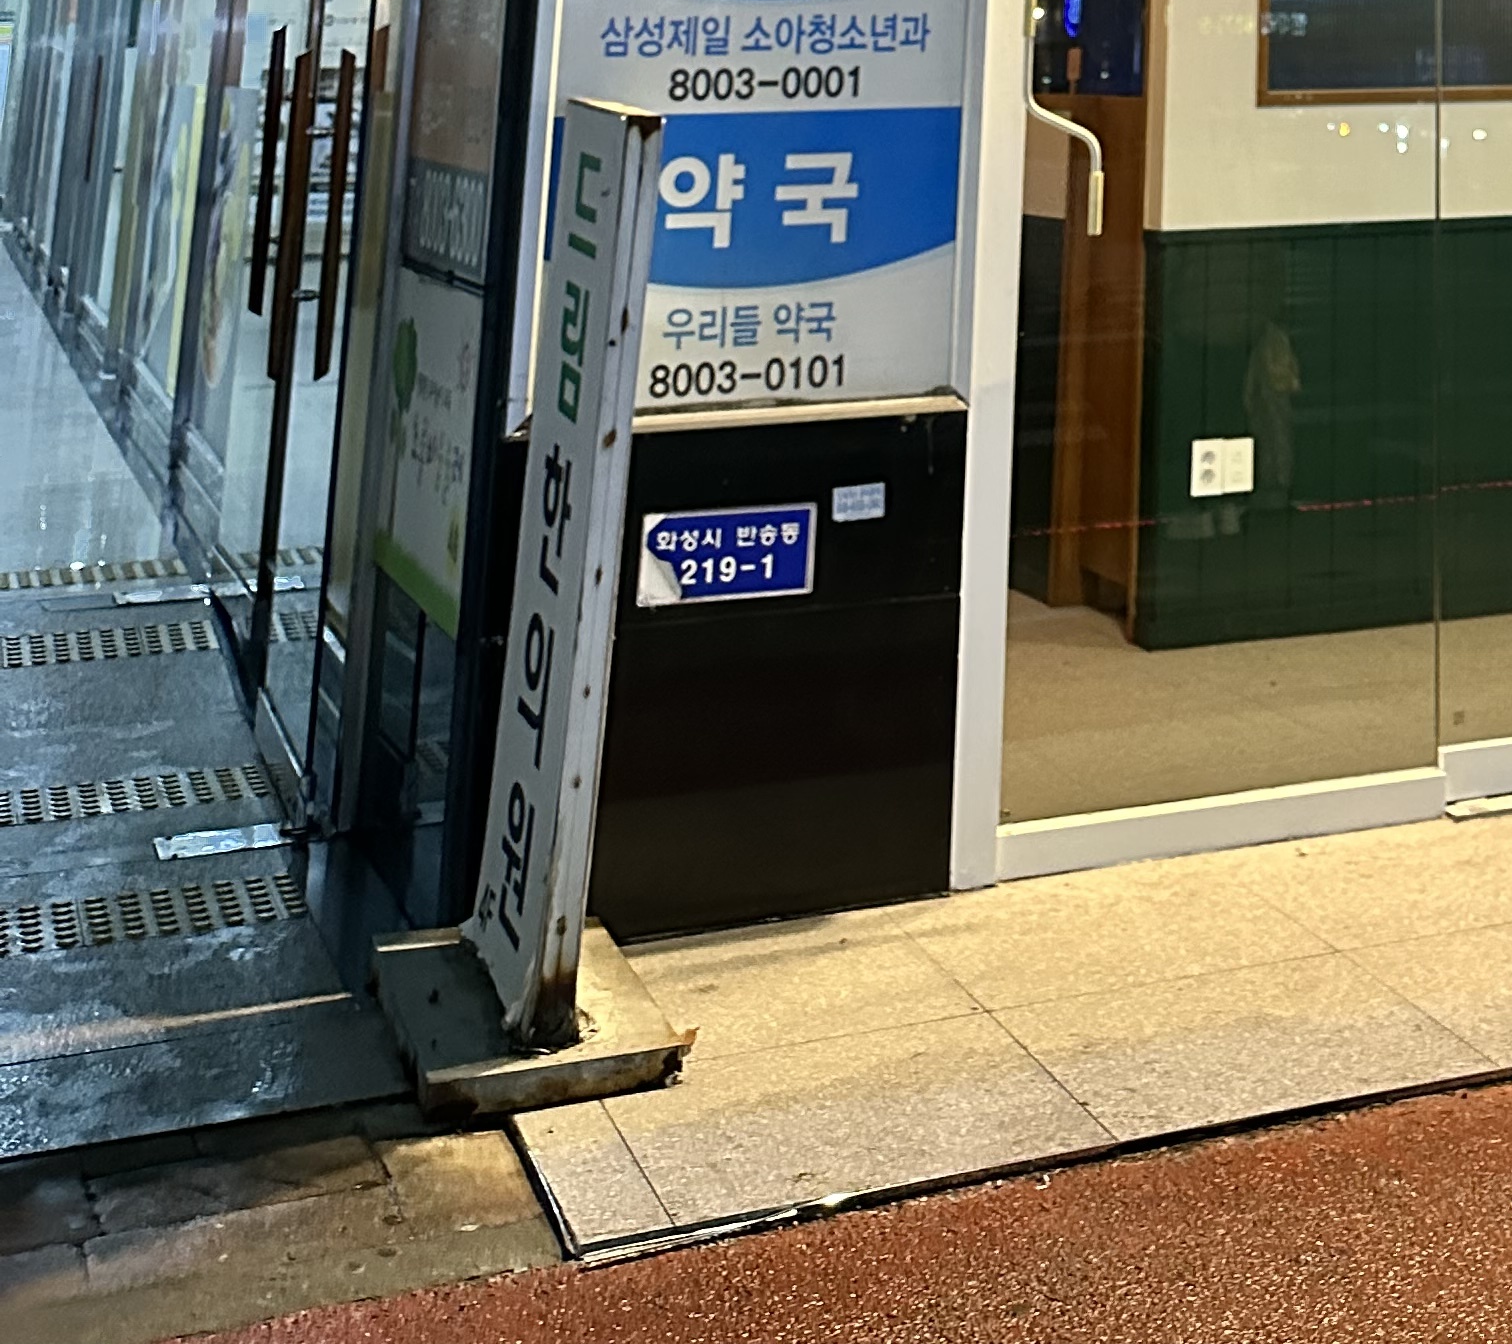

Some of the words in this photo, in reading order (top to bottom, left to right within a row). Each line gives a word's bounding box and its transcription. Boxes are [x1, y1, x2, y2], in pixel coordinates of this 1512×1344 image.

[600, 15, 731, 58] 삼성제일
[741, 12, 932, 55] 소아청소년과
[668, 66, 863, 102] 8003-0001
[662, 305, 763, 350] 우리들
[771, 300, 838, 345] 약국
[648, 354, 848, 399] 8003-0101
[656, 527, 723, 552] 화성시
[680, 553, 775, 586] 219-1
